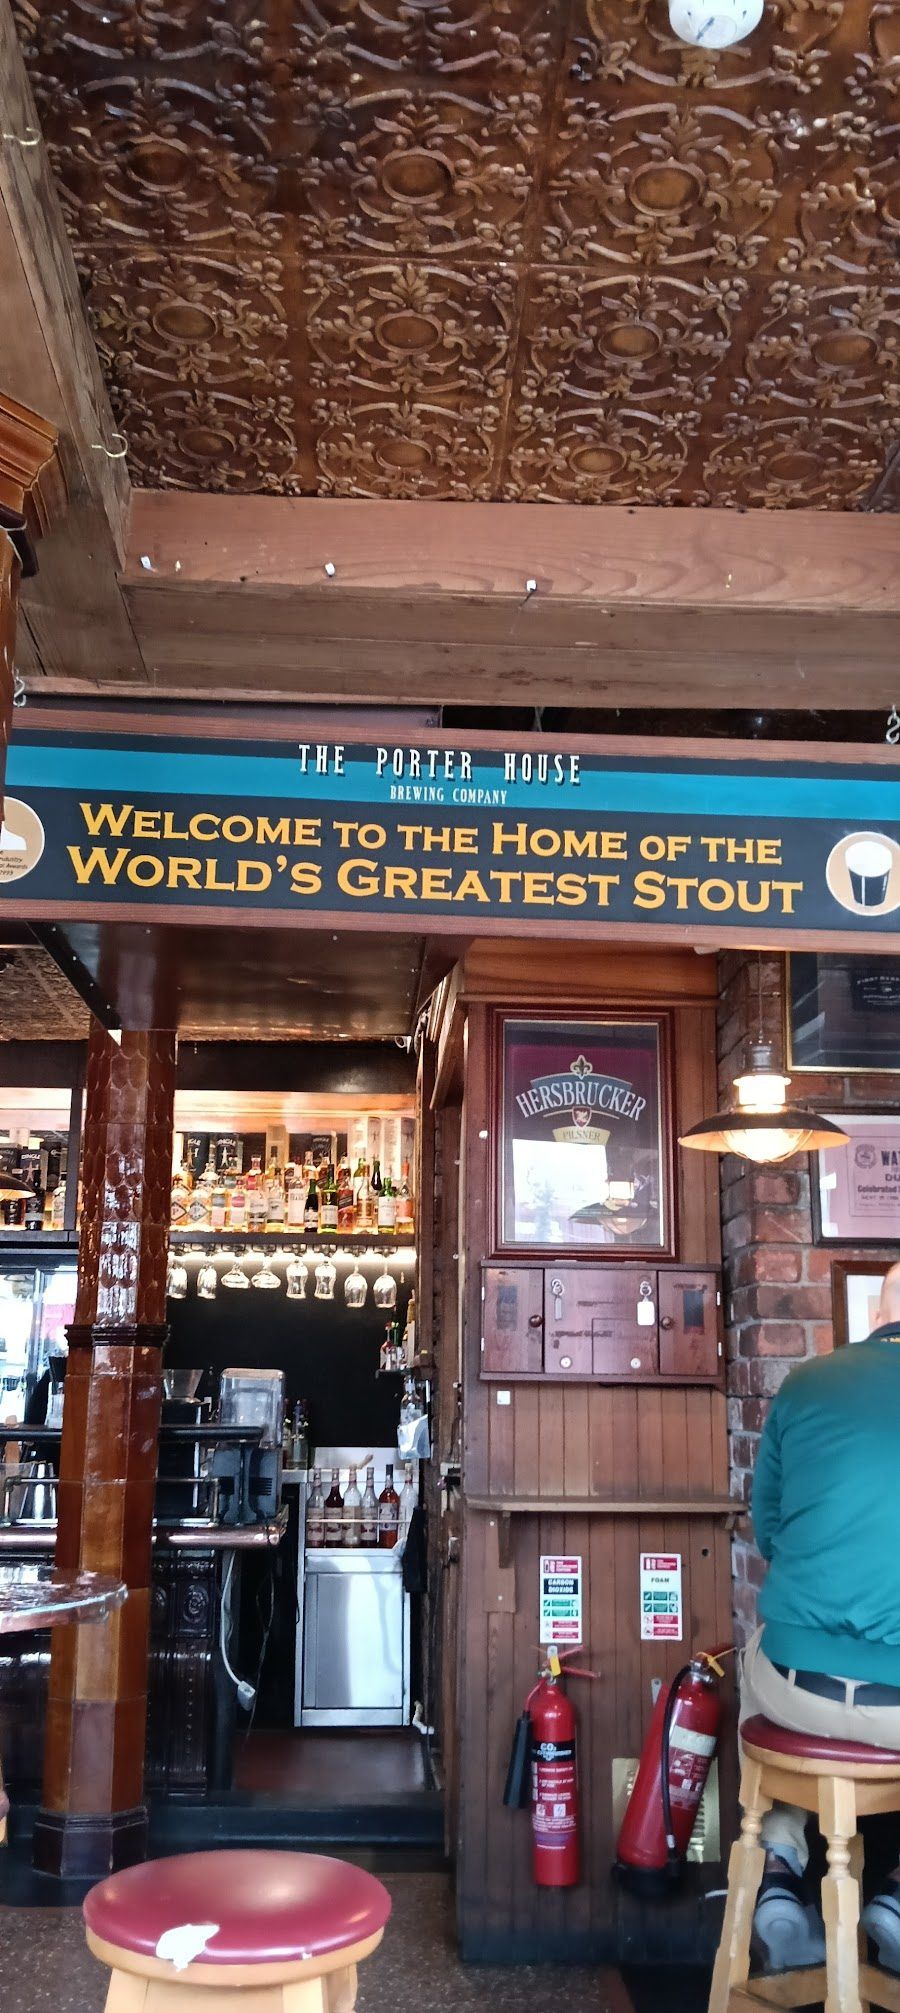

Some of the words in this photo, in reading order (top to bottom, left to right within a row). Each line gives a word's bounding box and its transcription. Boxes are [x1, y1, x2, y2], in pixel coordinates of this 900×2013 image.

[298, 744, 345, 774] THE
[376, 747, 472, 780] PORTER
[504, 752, 581, 784] HOUSE
[390, 785, 445, 802] BREWING
[452, 788, 508, 805] COMPANY
[79, 802, 322, 846] WELCOME
[333, 822, 387, 850] TO
[397, 825, 479, 854] THE
[492, 822, 627, 860] HOME
[639, 835, 692, 862] OF
[701, 837, 783, 865] THE
[66, 846, 323, 894] WORLD'S
[337, 858, 620, 906] GREATEST
[634, 870, 803, 913] STOUT
[515, 1081, 647, 1121] HERSBRUCKER
[562, 1130, 601, 1141] PILSNER
[857, 1184, 897, 1194] Celebrated
